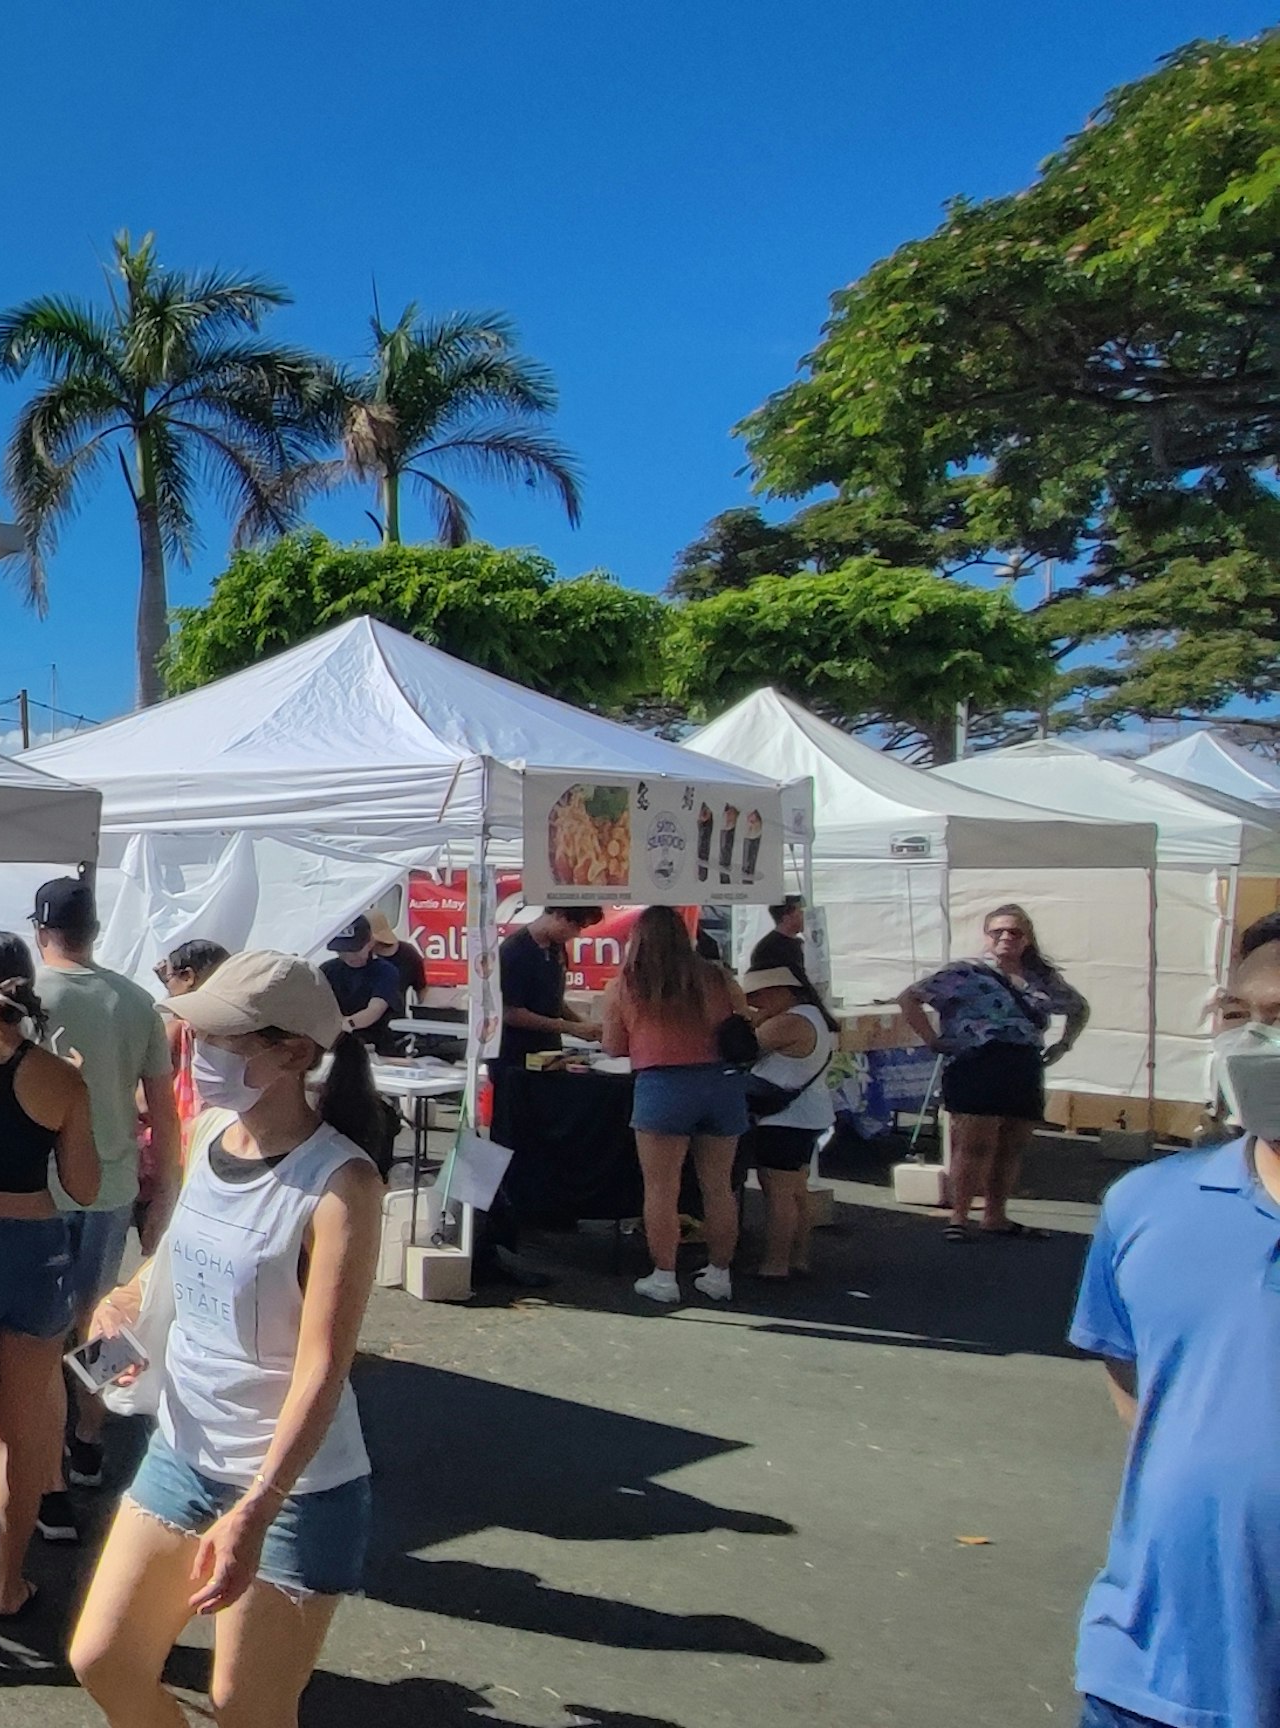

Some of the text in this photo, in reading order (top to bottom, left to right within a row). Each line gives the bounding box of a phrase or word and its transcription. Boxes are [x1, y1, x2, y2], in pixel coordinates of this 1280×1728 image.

[441, 899, 466, 911] May
[173, 1240, 235, 1279] ALOHA
[174, 1283, 231, 1322] STATE
